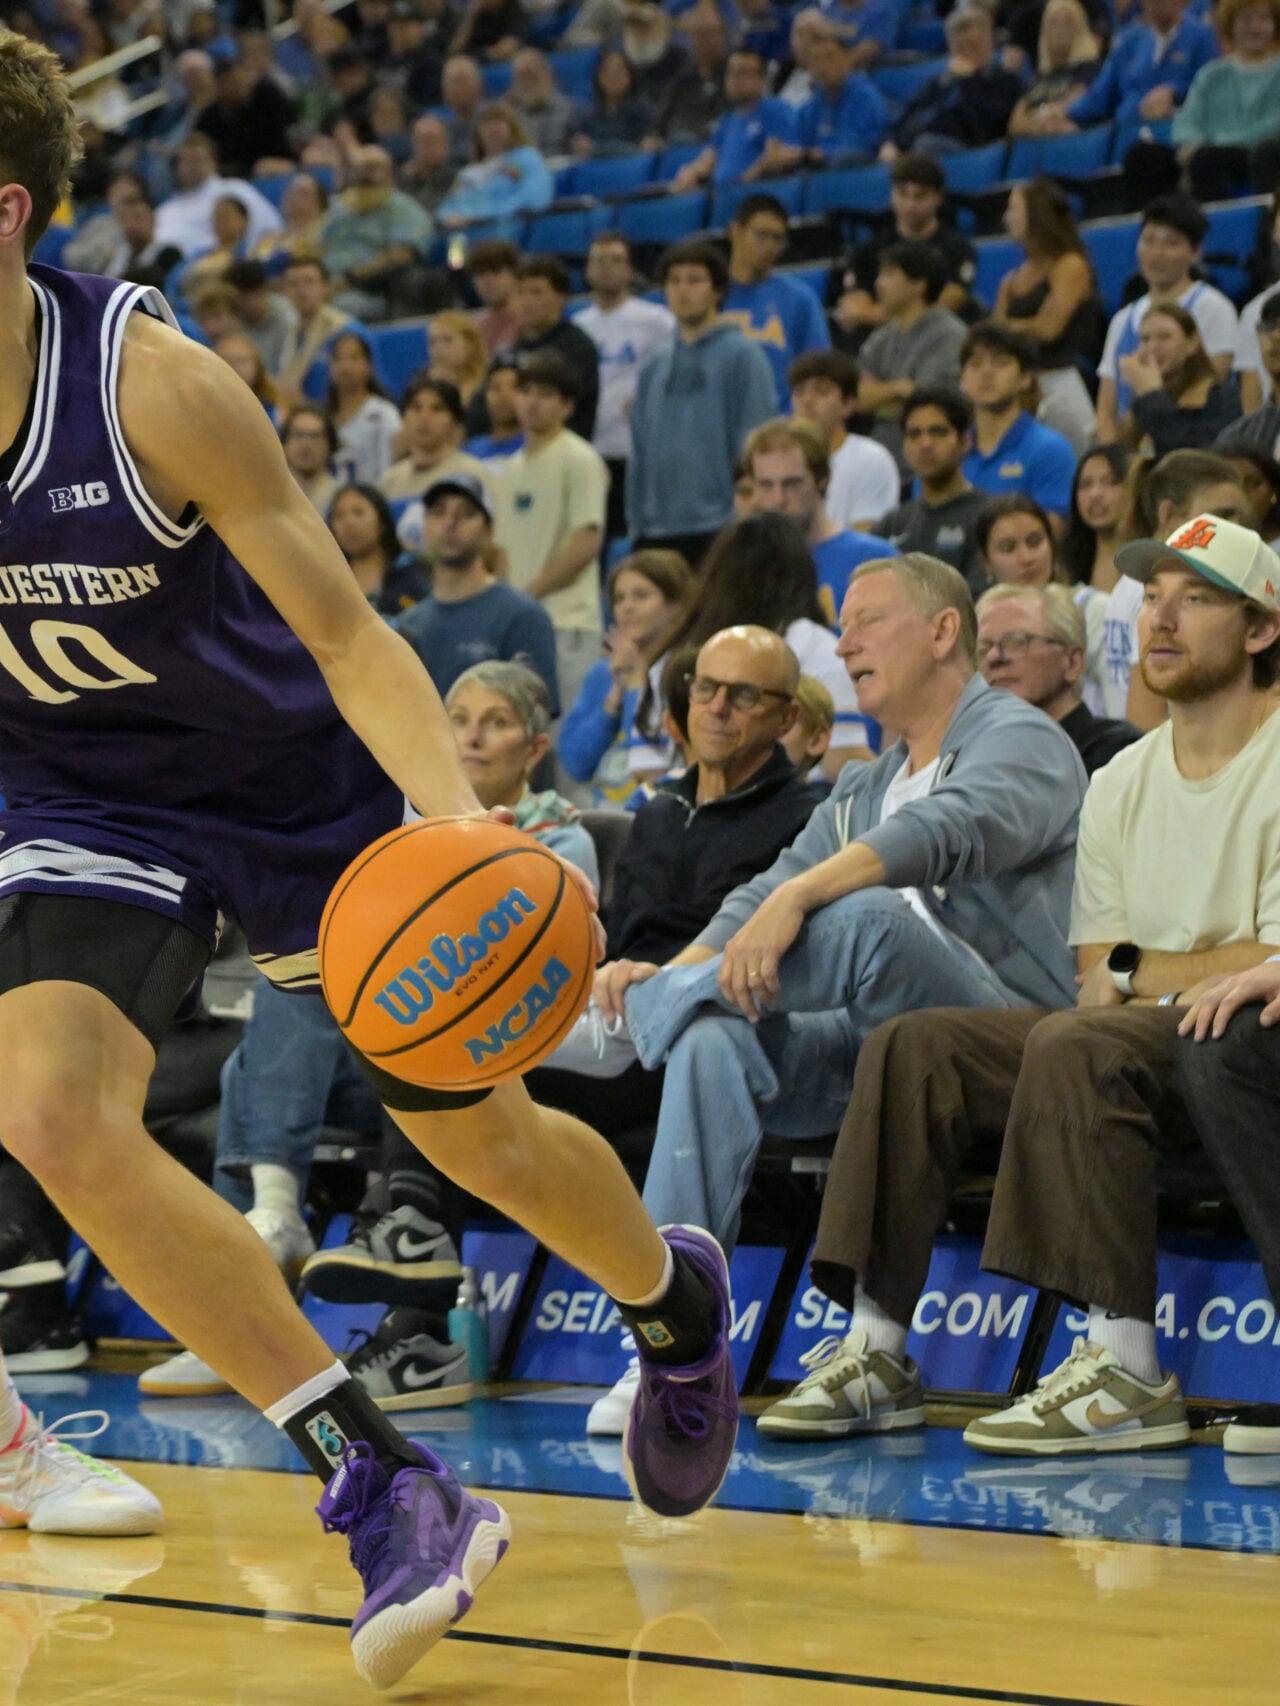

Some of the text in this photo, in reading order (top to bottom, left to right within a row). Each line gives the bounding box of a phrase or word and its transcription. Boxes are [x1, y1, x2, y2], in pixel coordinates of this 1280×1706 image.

[373, 886, 537, 1026] Wilson
[455, 974, 478, 998] EVO
[463, 957, 573, 1065] NCAA
